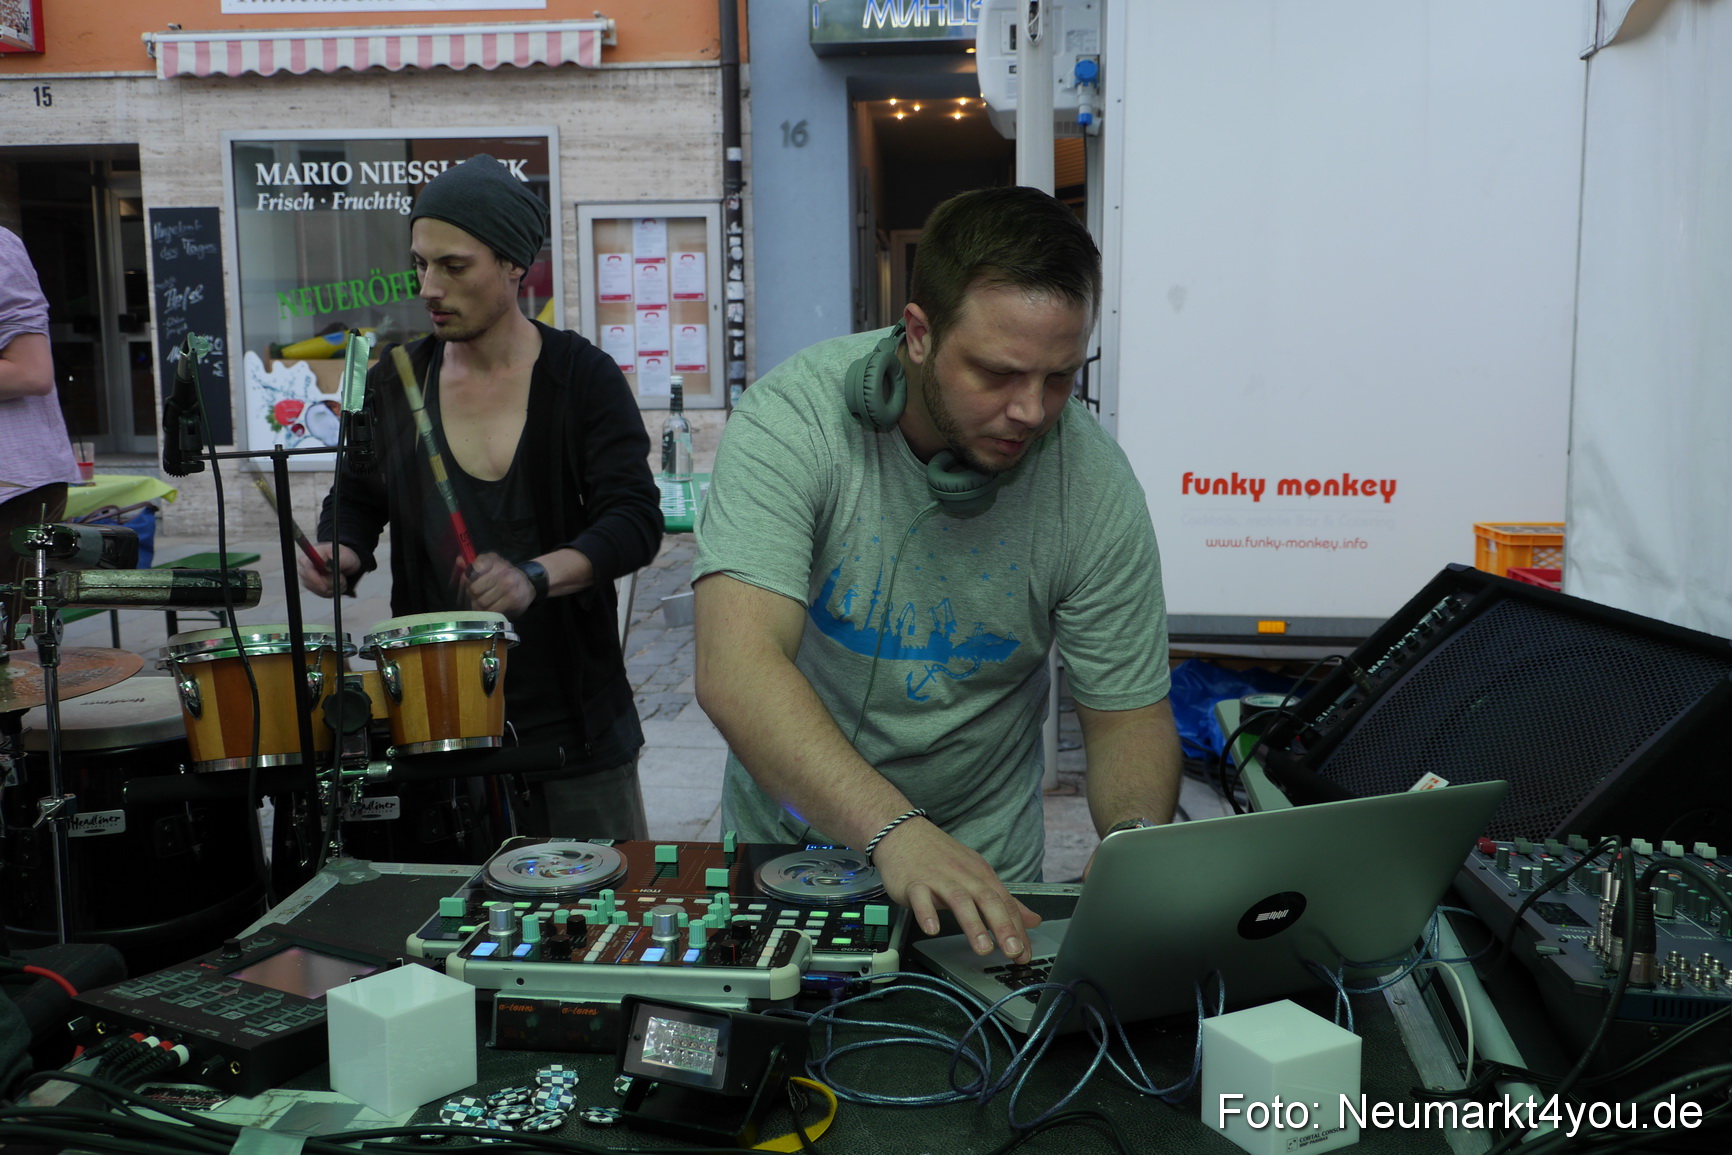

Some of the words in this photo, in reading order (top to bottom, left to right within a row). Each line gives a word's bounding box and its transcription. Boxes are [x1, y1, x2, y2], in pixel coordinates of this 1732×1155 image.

[33, 85, 52, 108] 15
[780, 120, 809, 149] 16
[255, 161, 353, 186] MARIO
[359, 159, 529, 186] NIESSK
[256, 193, 314, 211] Frisch
[331, 191, 412, 215] Fruchtig
[1182, 472, 1265, 502] funky
[1277, 473, 1397, 503] monkey
[1205, 536, 1369, 551] www.funky-monkey.info
[498, 1003, 535, 1012] a-tones
[562, 1006, 599, 1015] a-tones
[1299, 1131, 1321, 1143] CORTAL
[1321, 1126, 1347, 1137] CONSO
